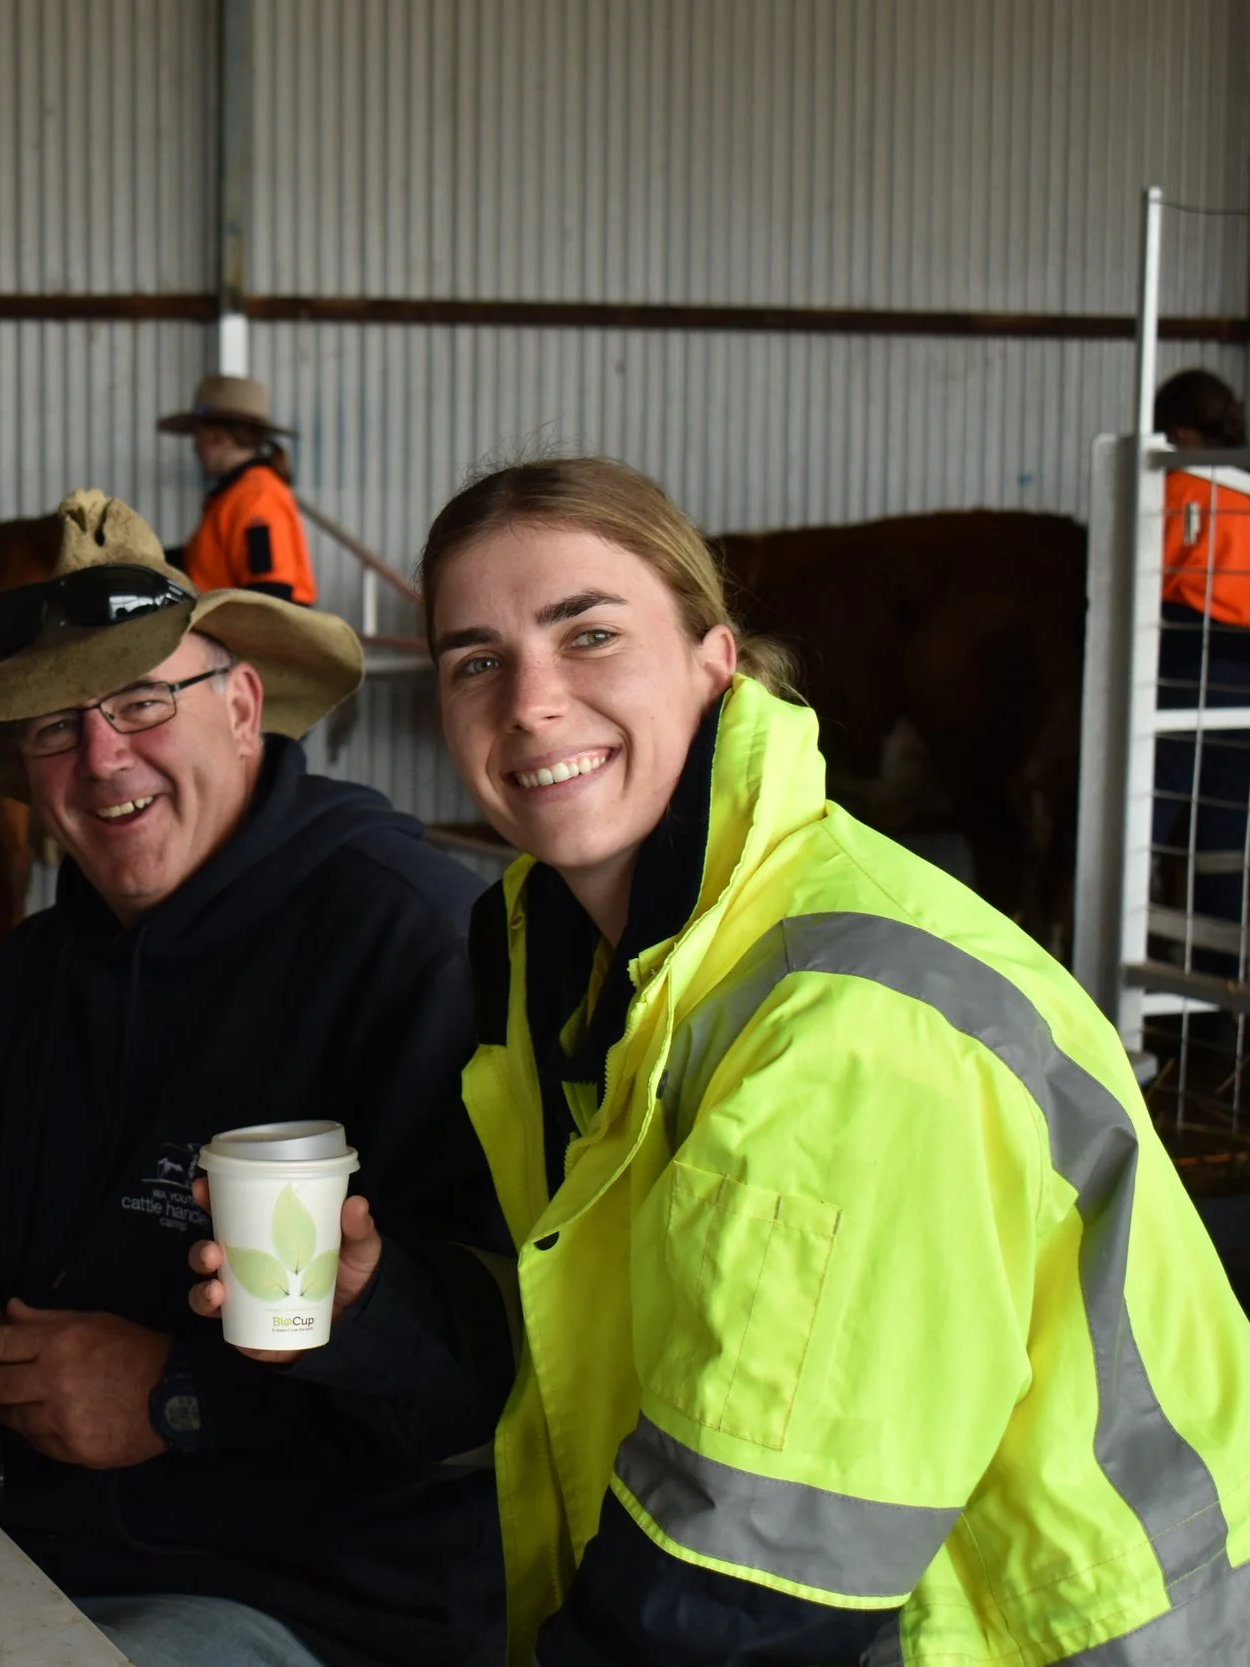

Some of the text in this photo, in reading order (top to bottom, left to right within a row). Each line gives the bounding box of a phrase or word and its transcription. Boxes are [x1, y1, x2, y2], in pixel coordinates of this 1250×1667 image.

[121, 1196, 162, 1214] cattle
[170, 1191, 194, 1205] YOUT
[272, 1315, 315, 1327] BioCup
